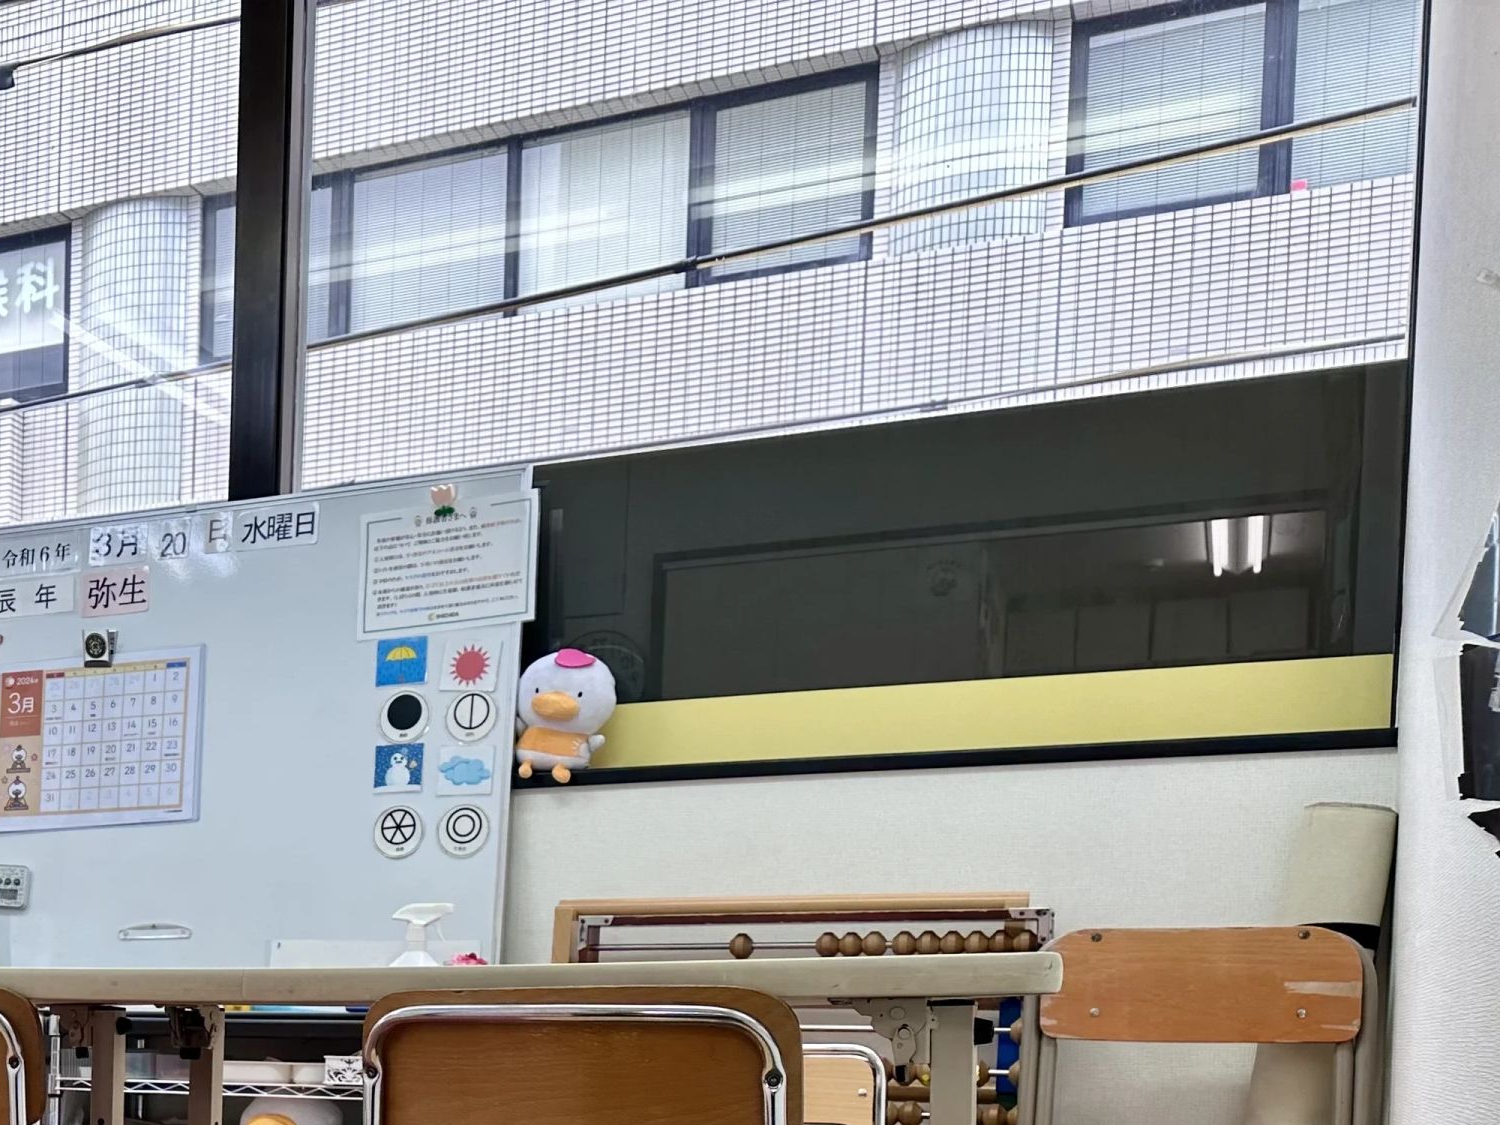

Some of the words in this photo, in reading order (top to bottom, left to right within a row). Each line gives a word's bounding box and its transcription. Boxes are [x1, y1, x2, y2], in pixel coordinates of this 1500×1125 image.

[2, 542, 71, 569] 令和6年
[95, 531, 138, 558] 3月
[161, 531, 186, 556] 20
[208, 519, 227, 543] 日
[241, 511, 316, 544] 水曜日
[88, 574, 147, 610] 弥生
[173, 672, 179, 681] 2
[7, 692, 34, 714] 3月
[51, 704, 57, 713] 3
[71, 703, 76, 712] 4
[90, 701, 96, 710] 5
[110, 700, 116, 709] 6
[130, 698, 136, 706] 7
[151, 696, 156, 705] 8
[49, 727, 57, 736] 10
[69, 726, 76, 734] 11
[88, 724, 96, 732] 12
[108, 722, 116, 731] 13
[127, 721, 136, 729] 14
[148, 719, 157, 728] 15
[169, 717, 177, 726] 16
[47, 749, 56, 757] 17
[68, 747, 76, 756] 18
[87, 746, 95, 755] 19
[105, 745, 116, 754] 20
[127, 743, 135, 752] 21
[146, 742, 157, 751] 22
[166, 740, 178, 749] 23
[46, 771, 56, 780] 24
[66, 770, 76, 779] 25
[85, 768, 96, 777] 26
[105, 767, 115, 776] 27
[125, 766, 135, 775] 28
[145, 764, 156, 773] 29
[165, 763, 176, 772] 30
[47, 793, 54, 801] 31
